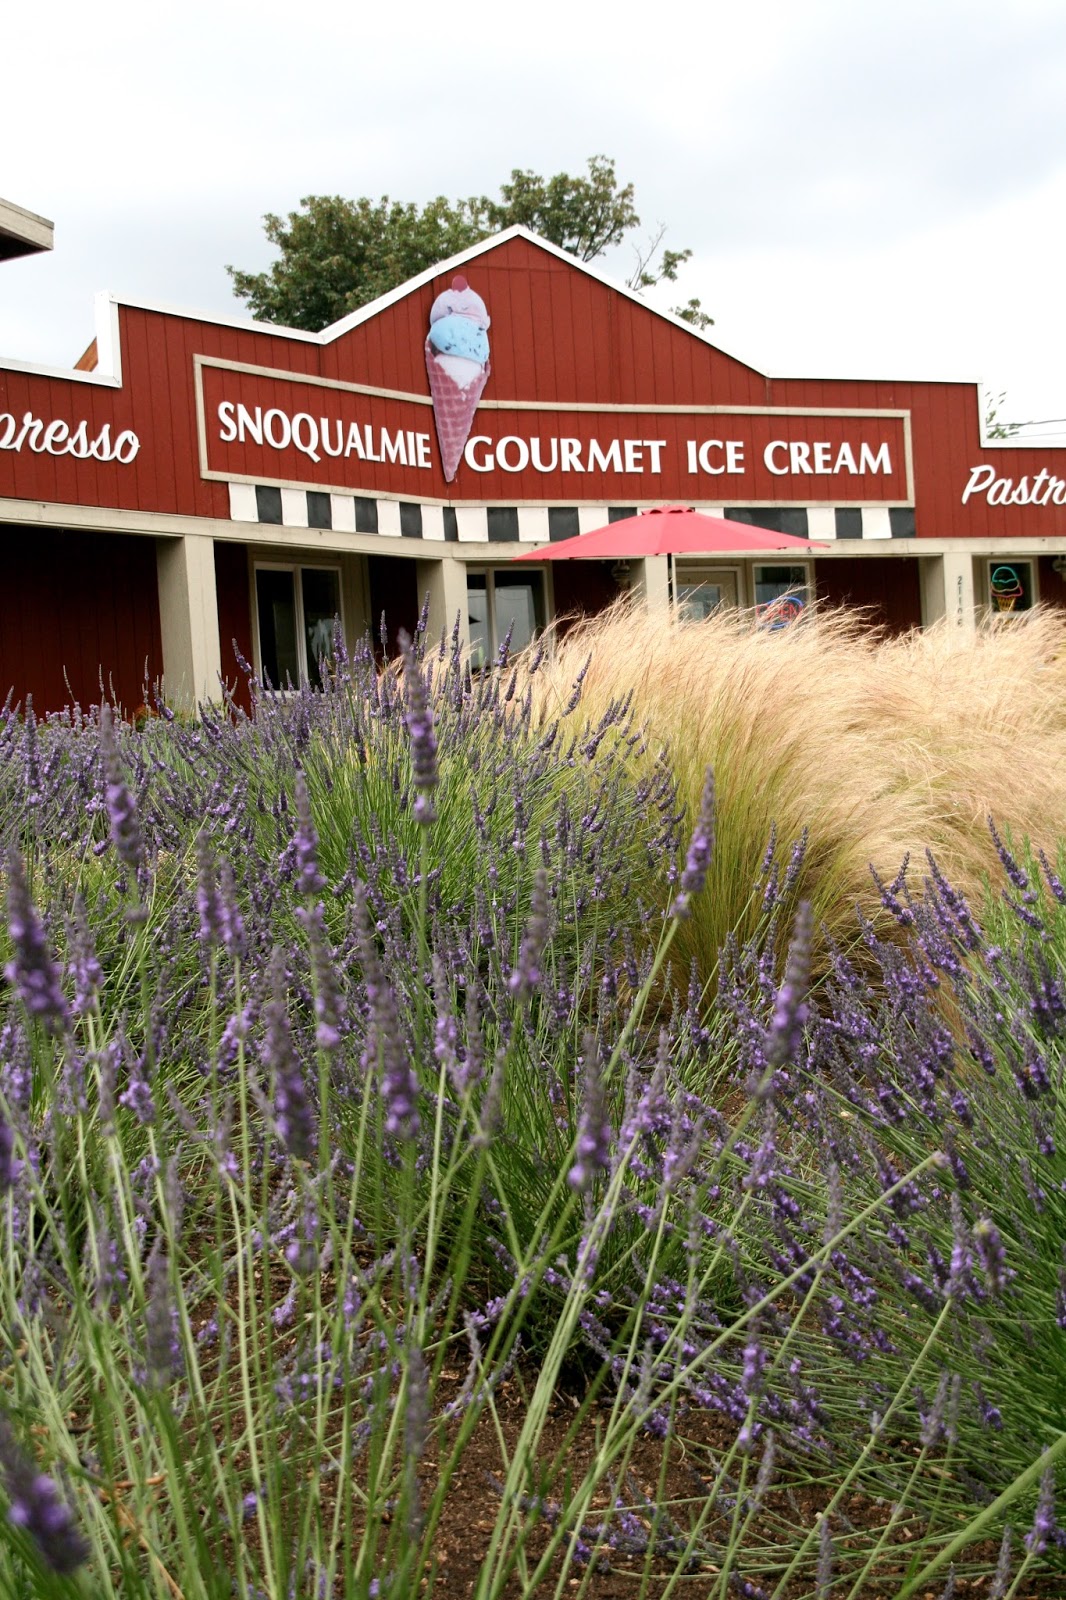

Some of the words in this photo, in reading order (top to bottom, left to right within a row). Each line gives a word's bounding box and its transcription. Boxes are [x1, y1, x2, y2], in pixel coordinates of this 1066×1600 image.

[217, 401, 432, 468] SNOQUALMIE
[464, 435, 666, 473] GOURMET
[686, 440, 746, 474] ICE
[763, 440, 893, 475] CREAM
